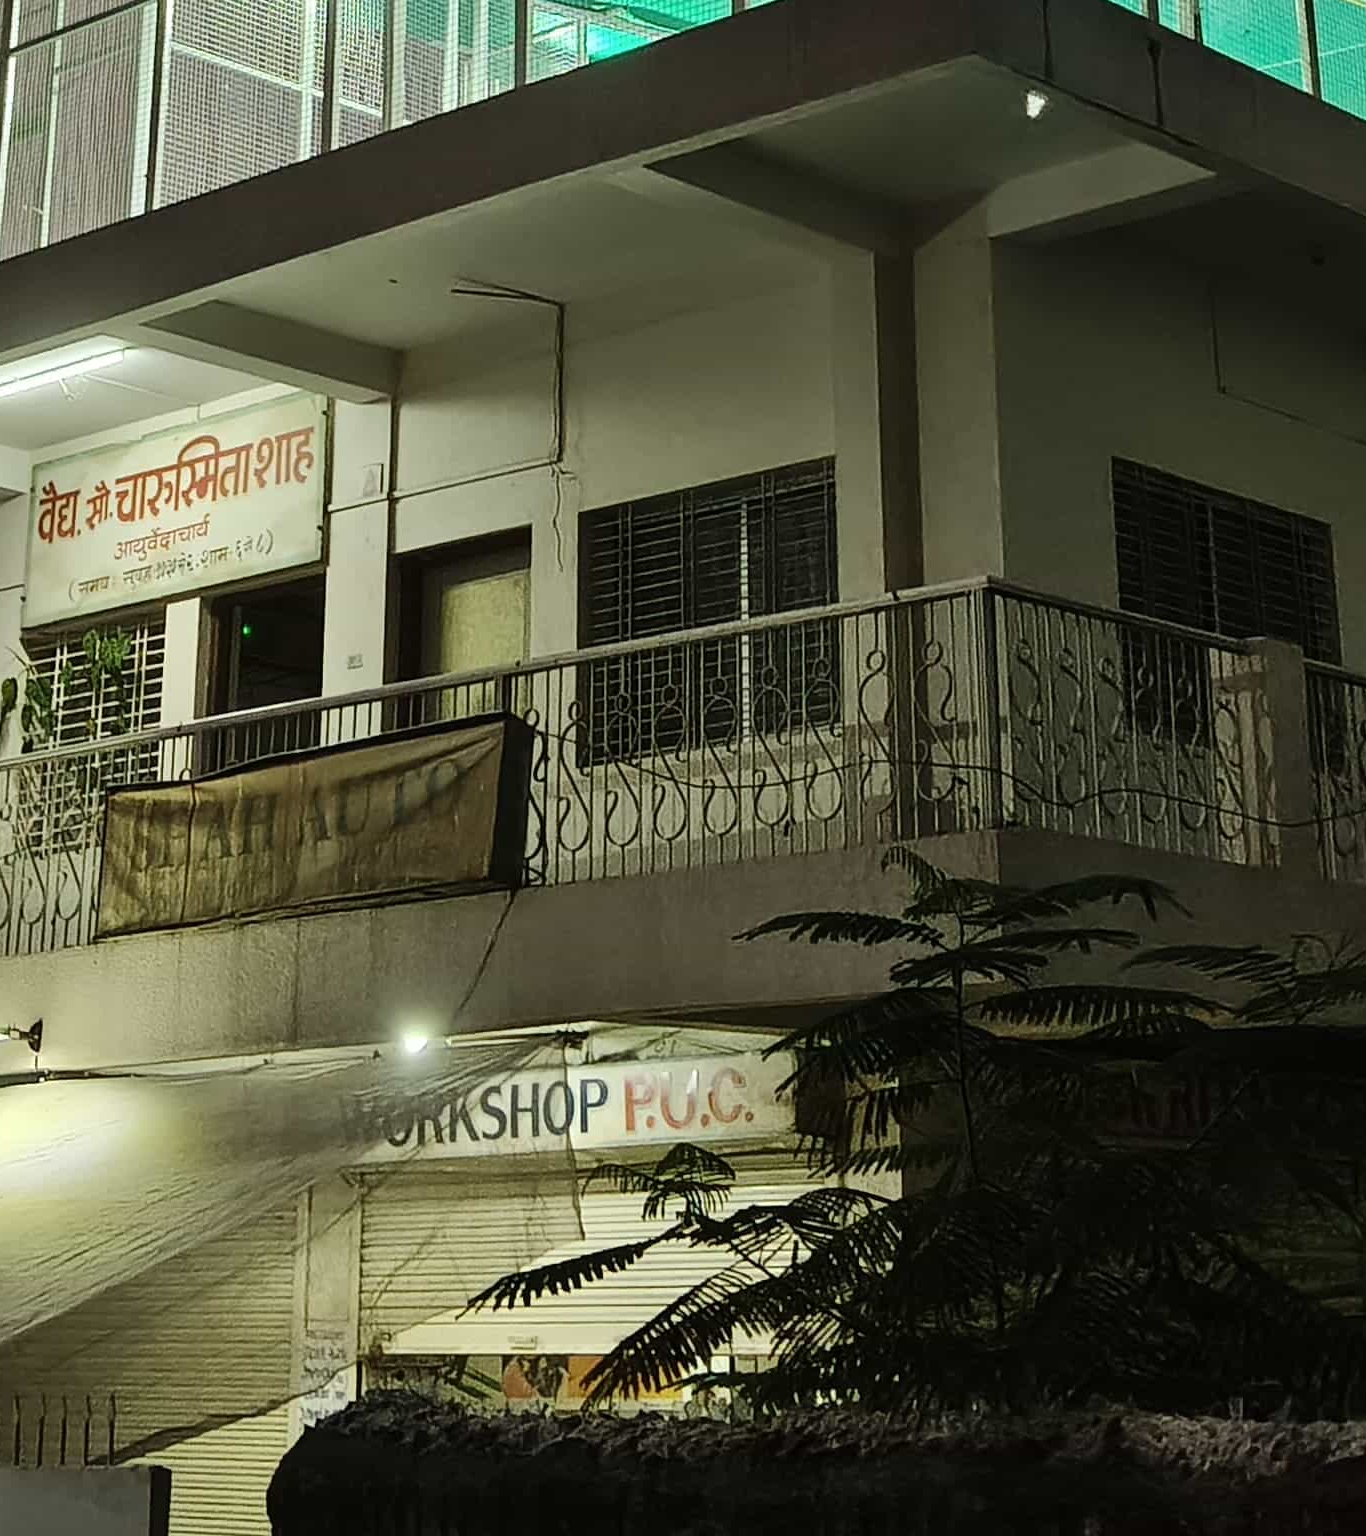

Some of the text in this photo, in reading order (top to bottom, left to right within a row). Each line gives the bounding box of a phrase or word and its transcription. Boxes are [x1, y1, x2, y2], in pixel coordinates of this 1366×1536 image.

[253, 427, 315, 489] शाह
[114, 514, 211, 562] आयुर्वेदाचार्य
[623, 1066, 756, 1138] P.U.C.
